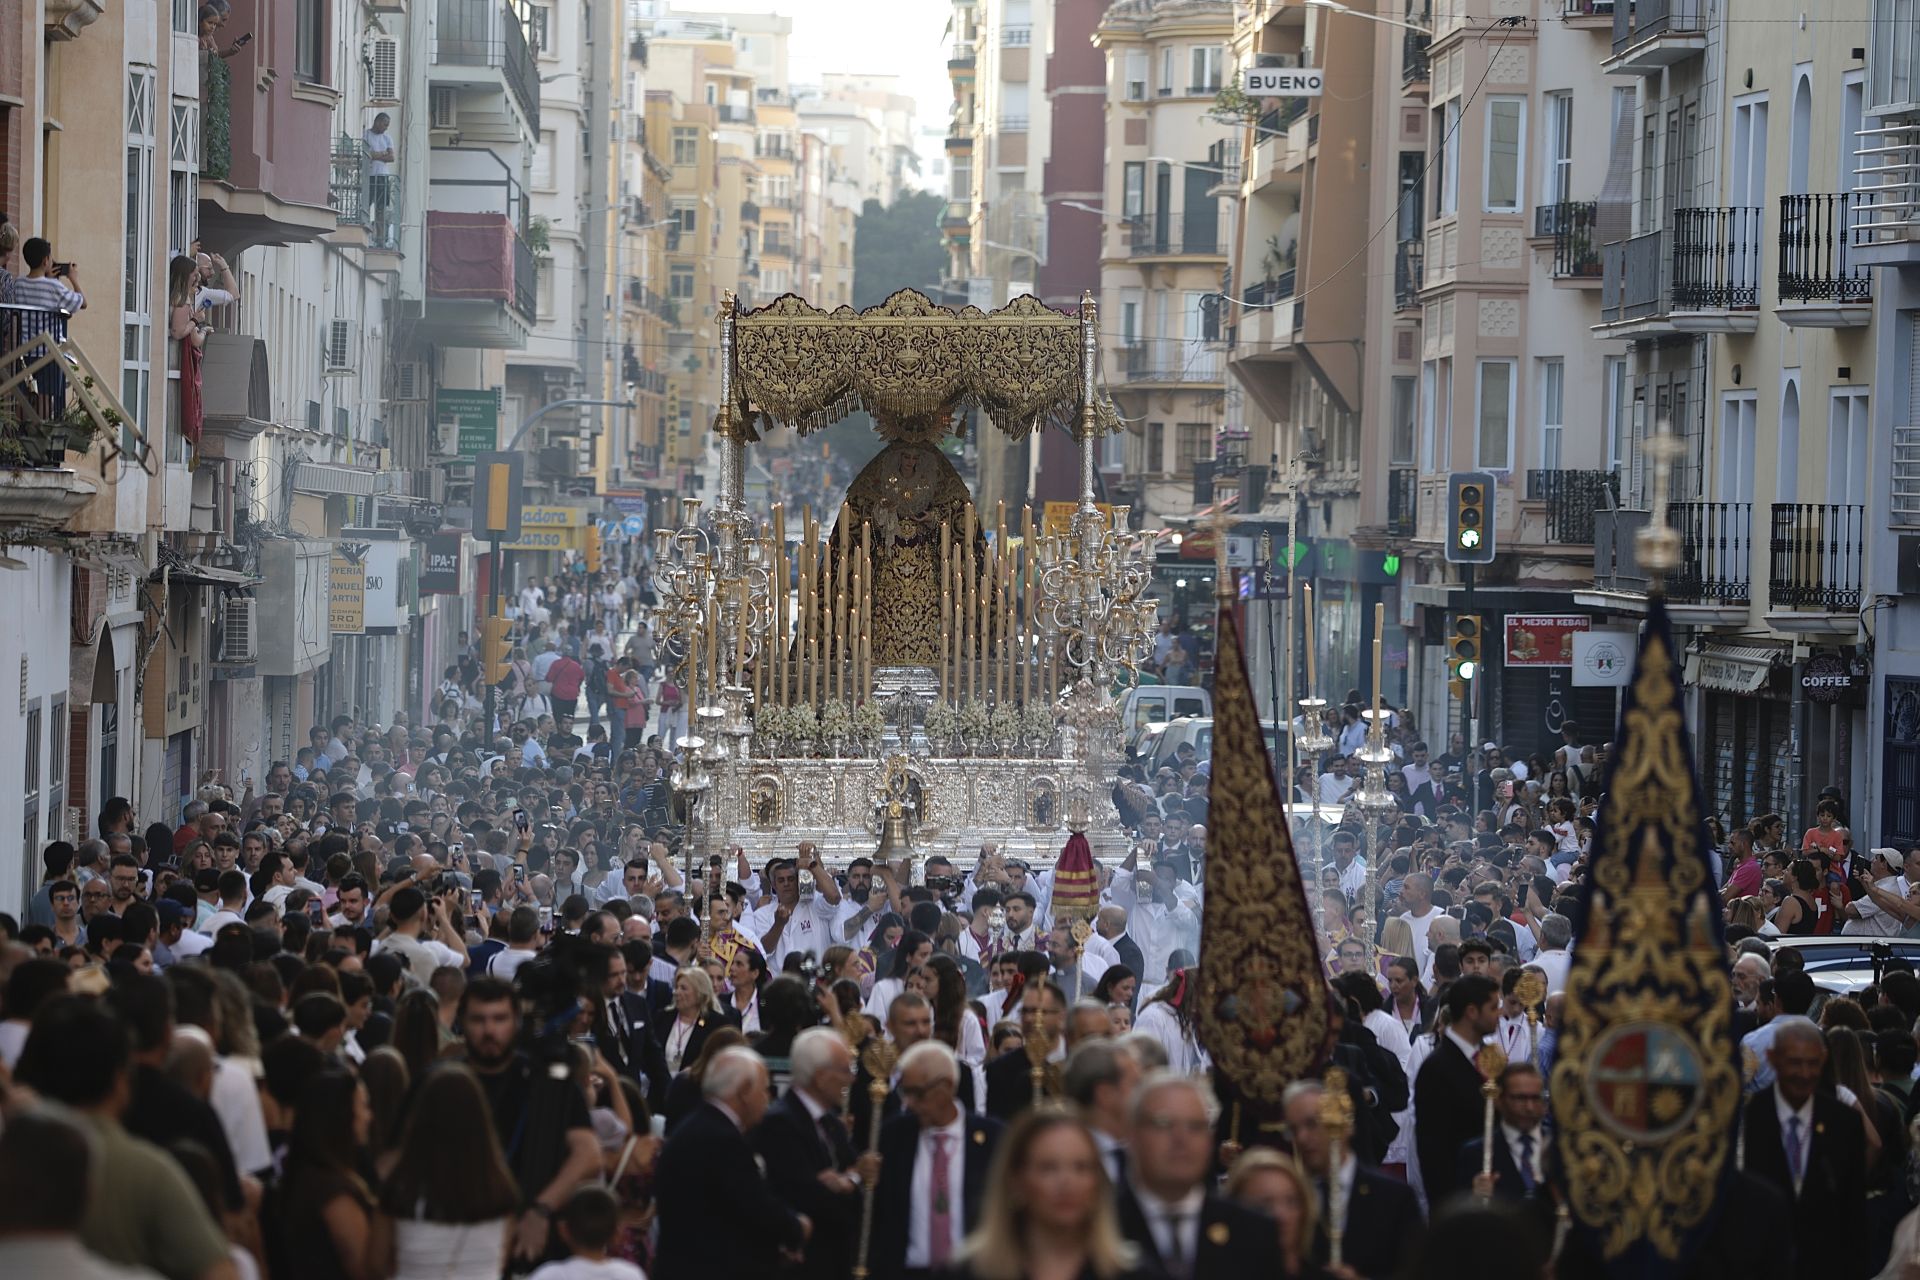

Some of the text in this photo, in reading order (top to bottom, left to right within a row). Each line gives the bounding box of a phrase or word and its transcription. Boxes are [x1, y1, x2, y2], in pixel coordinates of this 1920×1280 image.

[1249, 76, 1321, 89] BUENO
[668, 384, 677, 462] FARMACIA
[522, 508, 568, 524] adora
[517, 533, 560, 546] anso
[430, 554, 458, 567] IPA-T
[331, 582, 363, 590] ANUEL
[332, 594, 360, 602] ARTIN
[1508, 618, 1519, 626] EL
[1557, 619, 1588, 627] KEBAB
[1801, 676, 1851, 687] COFFEE
